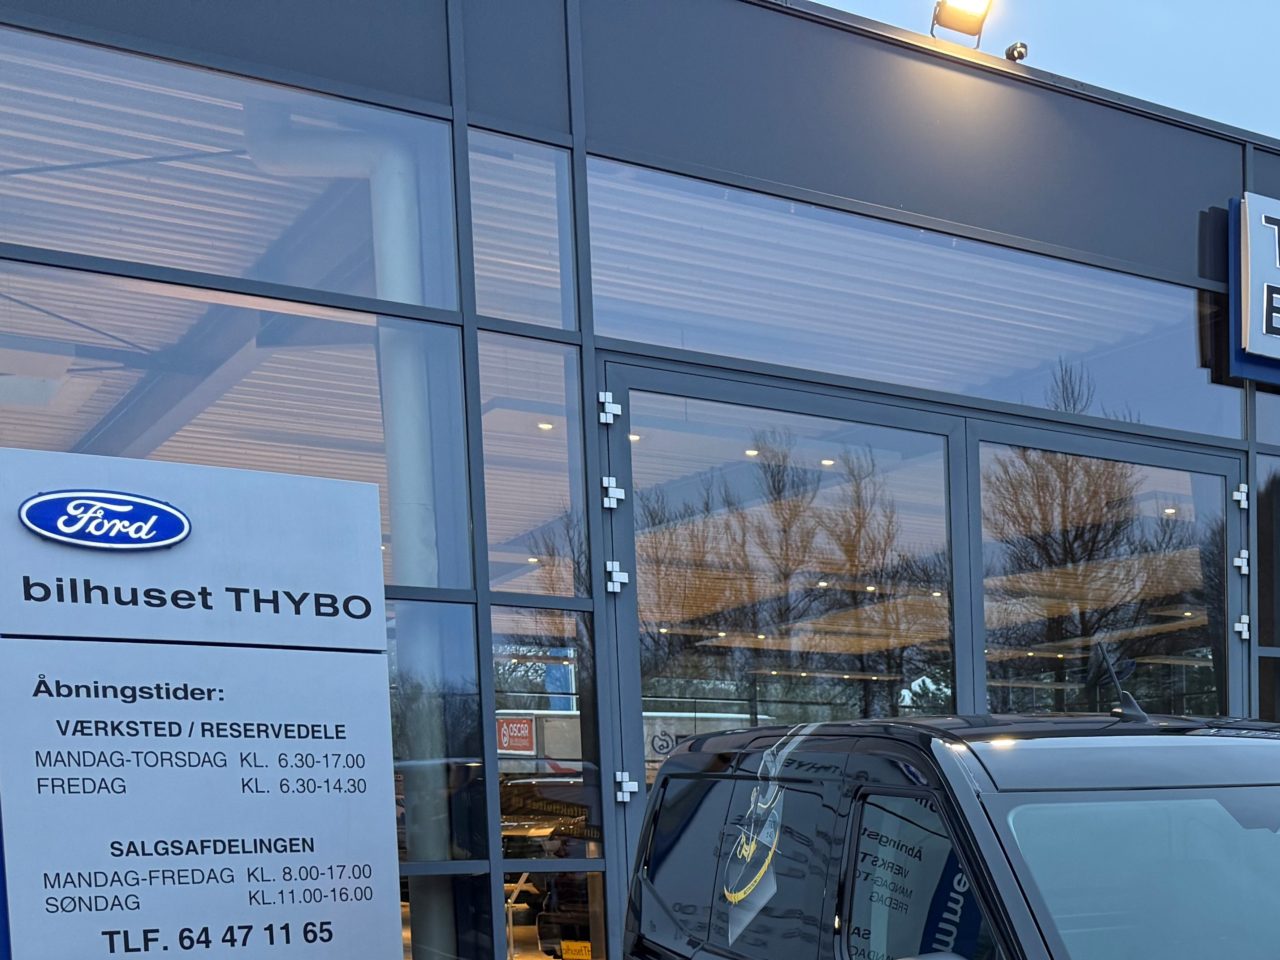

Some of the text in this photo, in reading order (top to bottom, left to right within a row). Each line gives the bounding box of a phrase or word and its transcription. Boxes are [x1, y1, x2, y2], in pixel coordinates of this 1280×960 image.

[56, 499, 159, 540] Ford
[22, 575, 372, 620] bilhuset THYBO
[32, 673, 225, 704] Åbningstider:
[55, 719, 183, 738] VÆRKSTED
[200, 721, 347, 740] RESERVEDELE
[34, 750, 366, 769] MANDAG-TORSDAG KL. 6.30-17.00
[36, 777, 367, 795] FREDAG KL. 6.30-14.30
[110, 837, 315, 858] SALGSAFDELINGEN
[43, 863, 372, 890] MANDAG-FREDAG KL. 8.00-17.00
[45, 893, 141, 914] SØNDAG
[101, 920, 334, 954] TLF. 64 47 11 65
